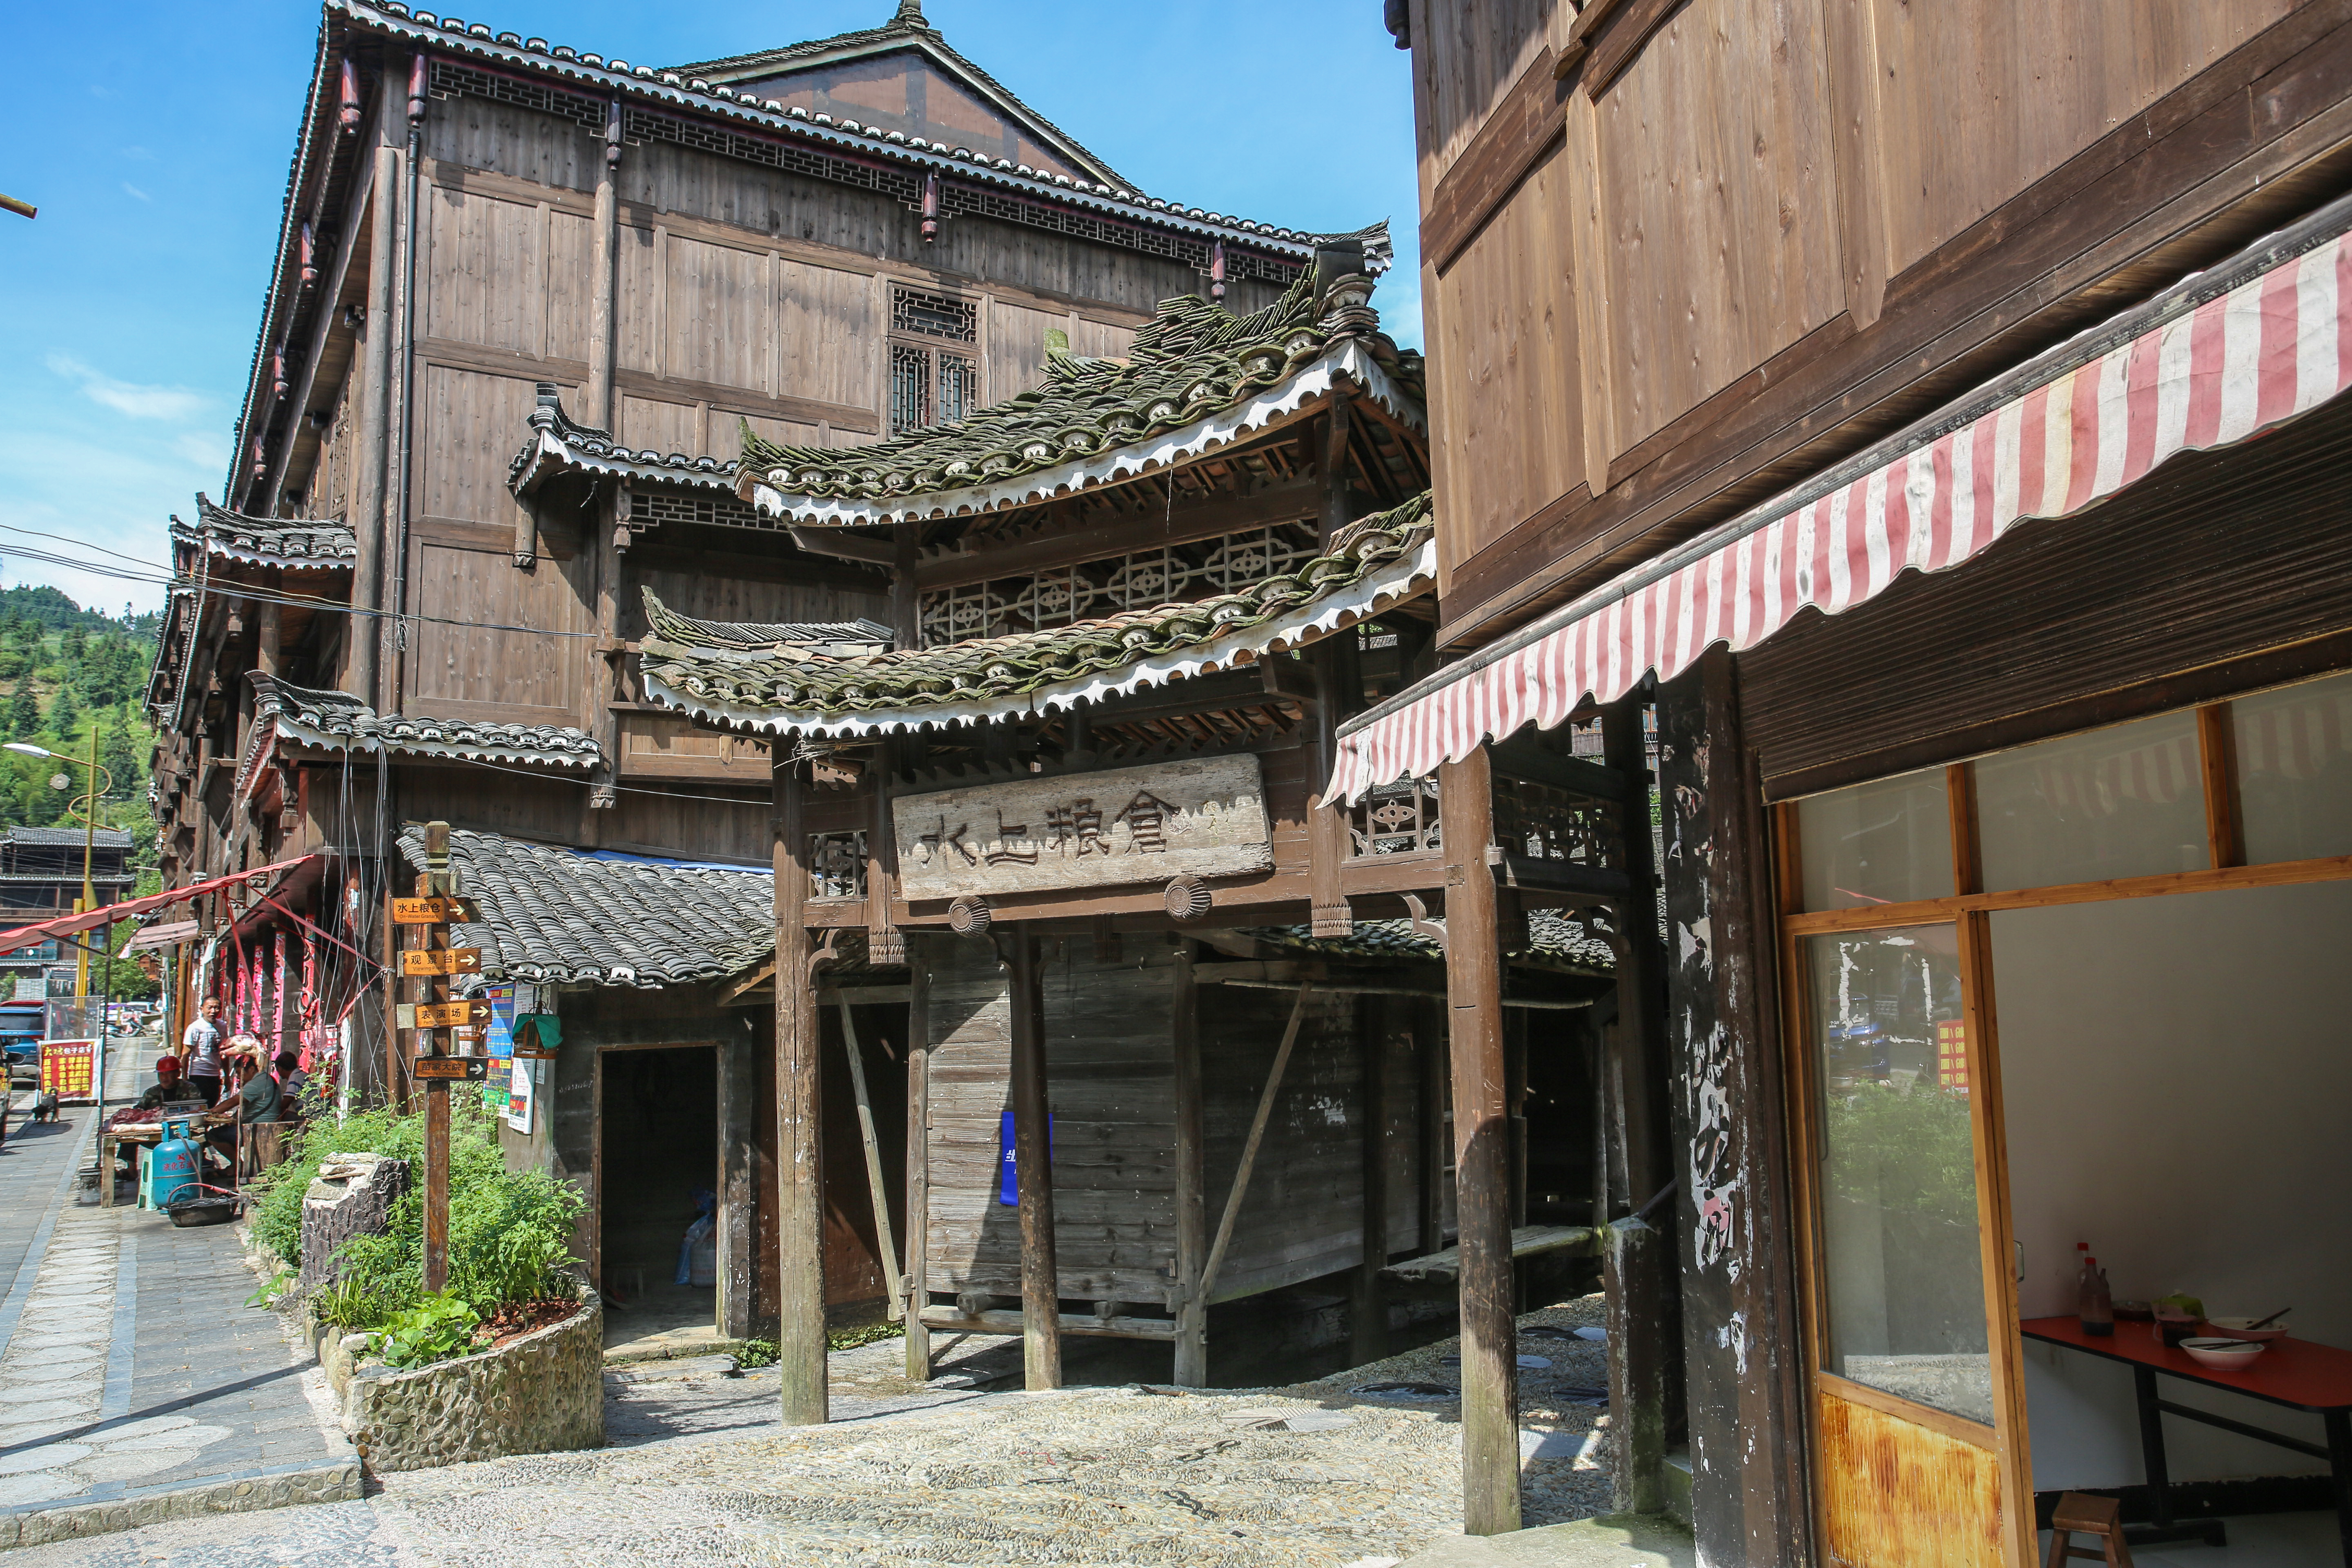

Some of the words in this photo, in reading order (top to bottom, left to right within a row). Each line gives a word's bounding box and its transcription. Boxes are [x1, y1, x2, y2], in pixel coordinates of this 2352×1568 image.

[398, 902, 440, 913] 水上粮仓
[411, 953, 453, 965] 观景台
[421, 1008, 461, 1019] 表演场
[422, 1062, 461, 1071] 苗家大院
